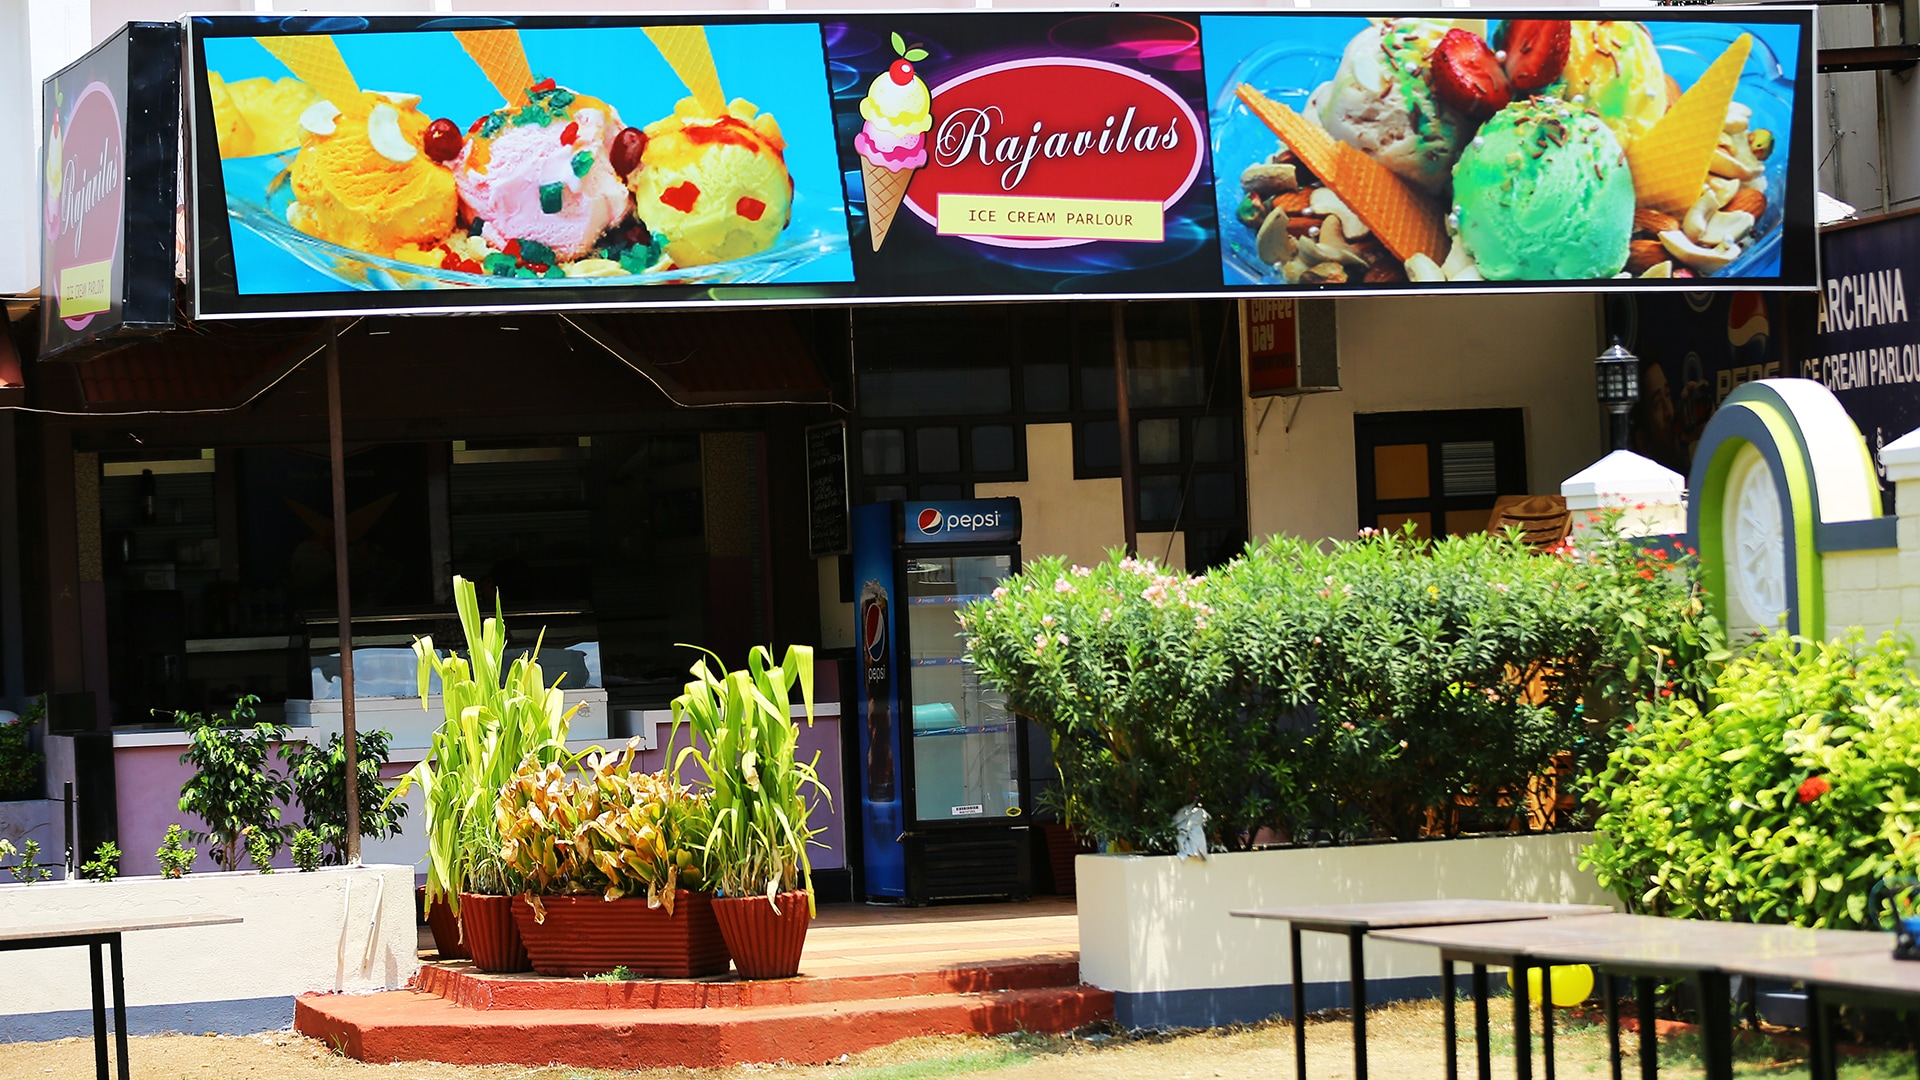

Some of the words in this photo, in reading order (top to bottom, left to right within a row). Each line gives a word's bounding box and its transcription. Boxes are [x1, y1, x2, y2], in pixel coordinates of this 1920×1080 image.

[935, 105, 1179, 191] Rajavilas
[61, 137, 118, 259] Rajavilas
[968, 209, 997, 222] ICE
[1007, 210, 1056, 224] CREAM
[1066, 212, 1133, 226] PARLOUR
[66, 285, 74, 300] ICE
[1817, 268, 1909, 335] ARCHANA
[1822, 349, 1868, 391] CREAM
[946, 510, 1000, 532] pepsi
[867, 664, 886, 683] pepsi
